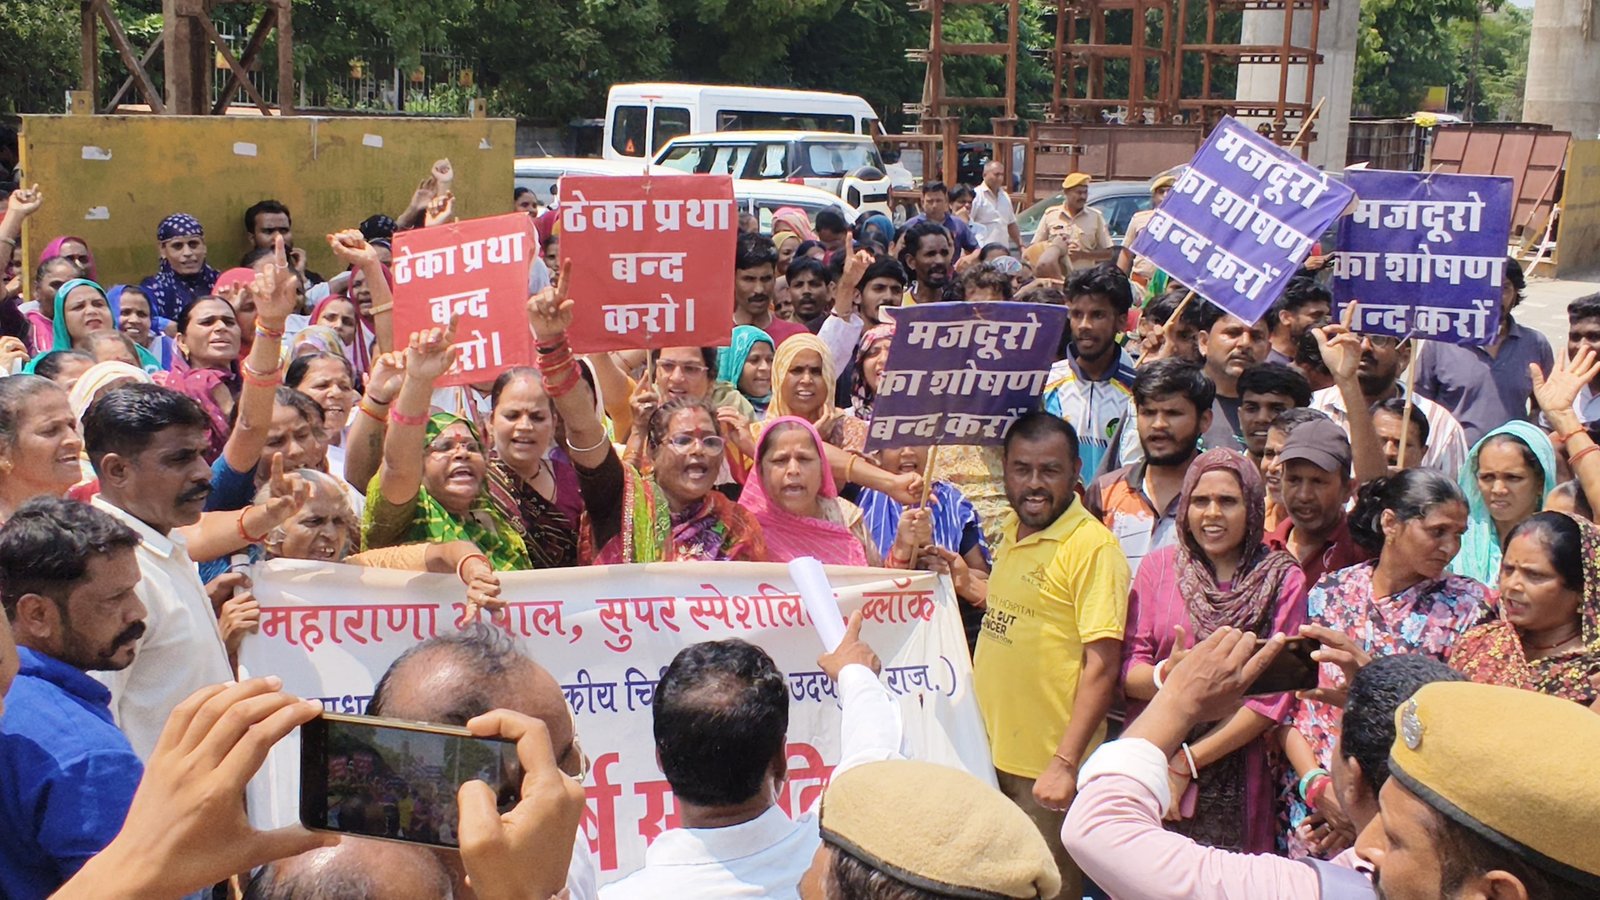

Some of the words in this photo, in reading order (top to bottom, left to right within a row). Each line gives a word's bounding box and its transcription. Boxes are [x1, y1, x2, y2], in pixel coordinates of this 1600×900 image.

[653, 199, 733, 233] प्रथा
[1173, 166, 1218, 205] का
[1210, 194, 1315, 264] शोषण
[461, 232, 526, 273] प्रथा
[609, 252, 687, 283] बन्द
[1147, 208, 1212, 264] बन्द
[1206, 244, 1281, 301] करों
[1333, 251, 1380, 281] का
[1384, 244, 1507, 287] शोषण
[429, 288, 490, 325] बन्द
[1415, 300, 1494, 339] करों
[446, 330, 502, 374] रो।
[876, 370, 928, 396] का
[929, 360, 1050, 396] शोषण
[870, 412, 943, 441] बन्द
[259, 603, 440, 652] महाराणा
[596, 597, 680, 653] सुपर
[861, 578, 936, 624] ब्लॉक
